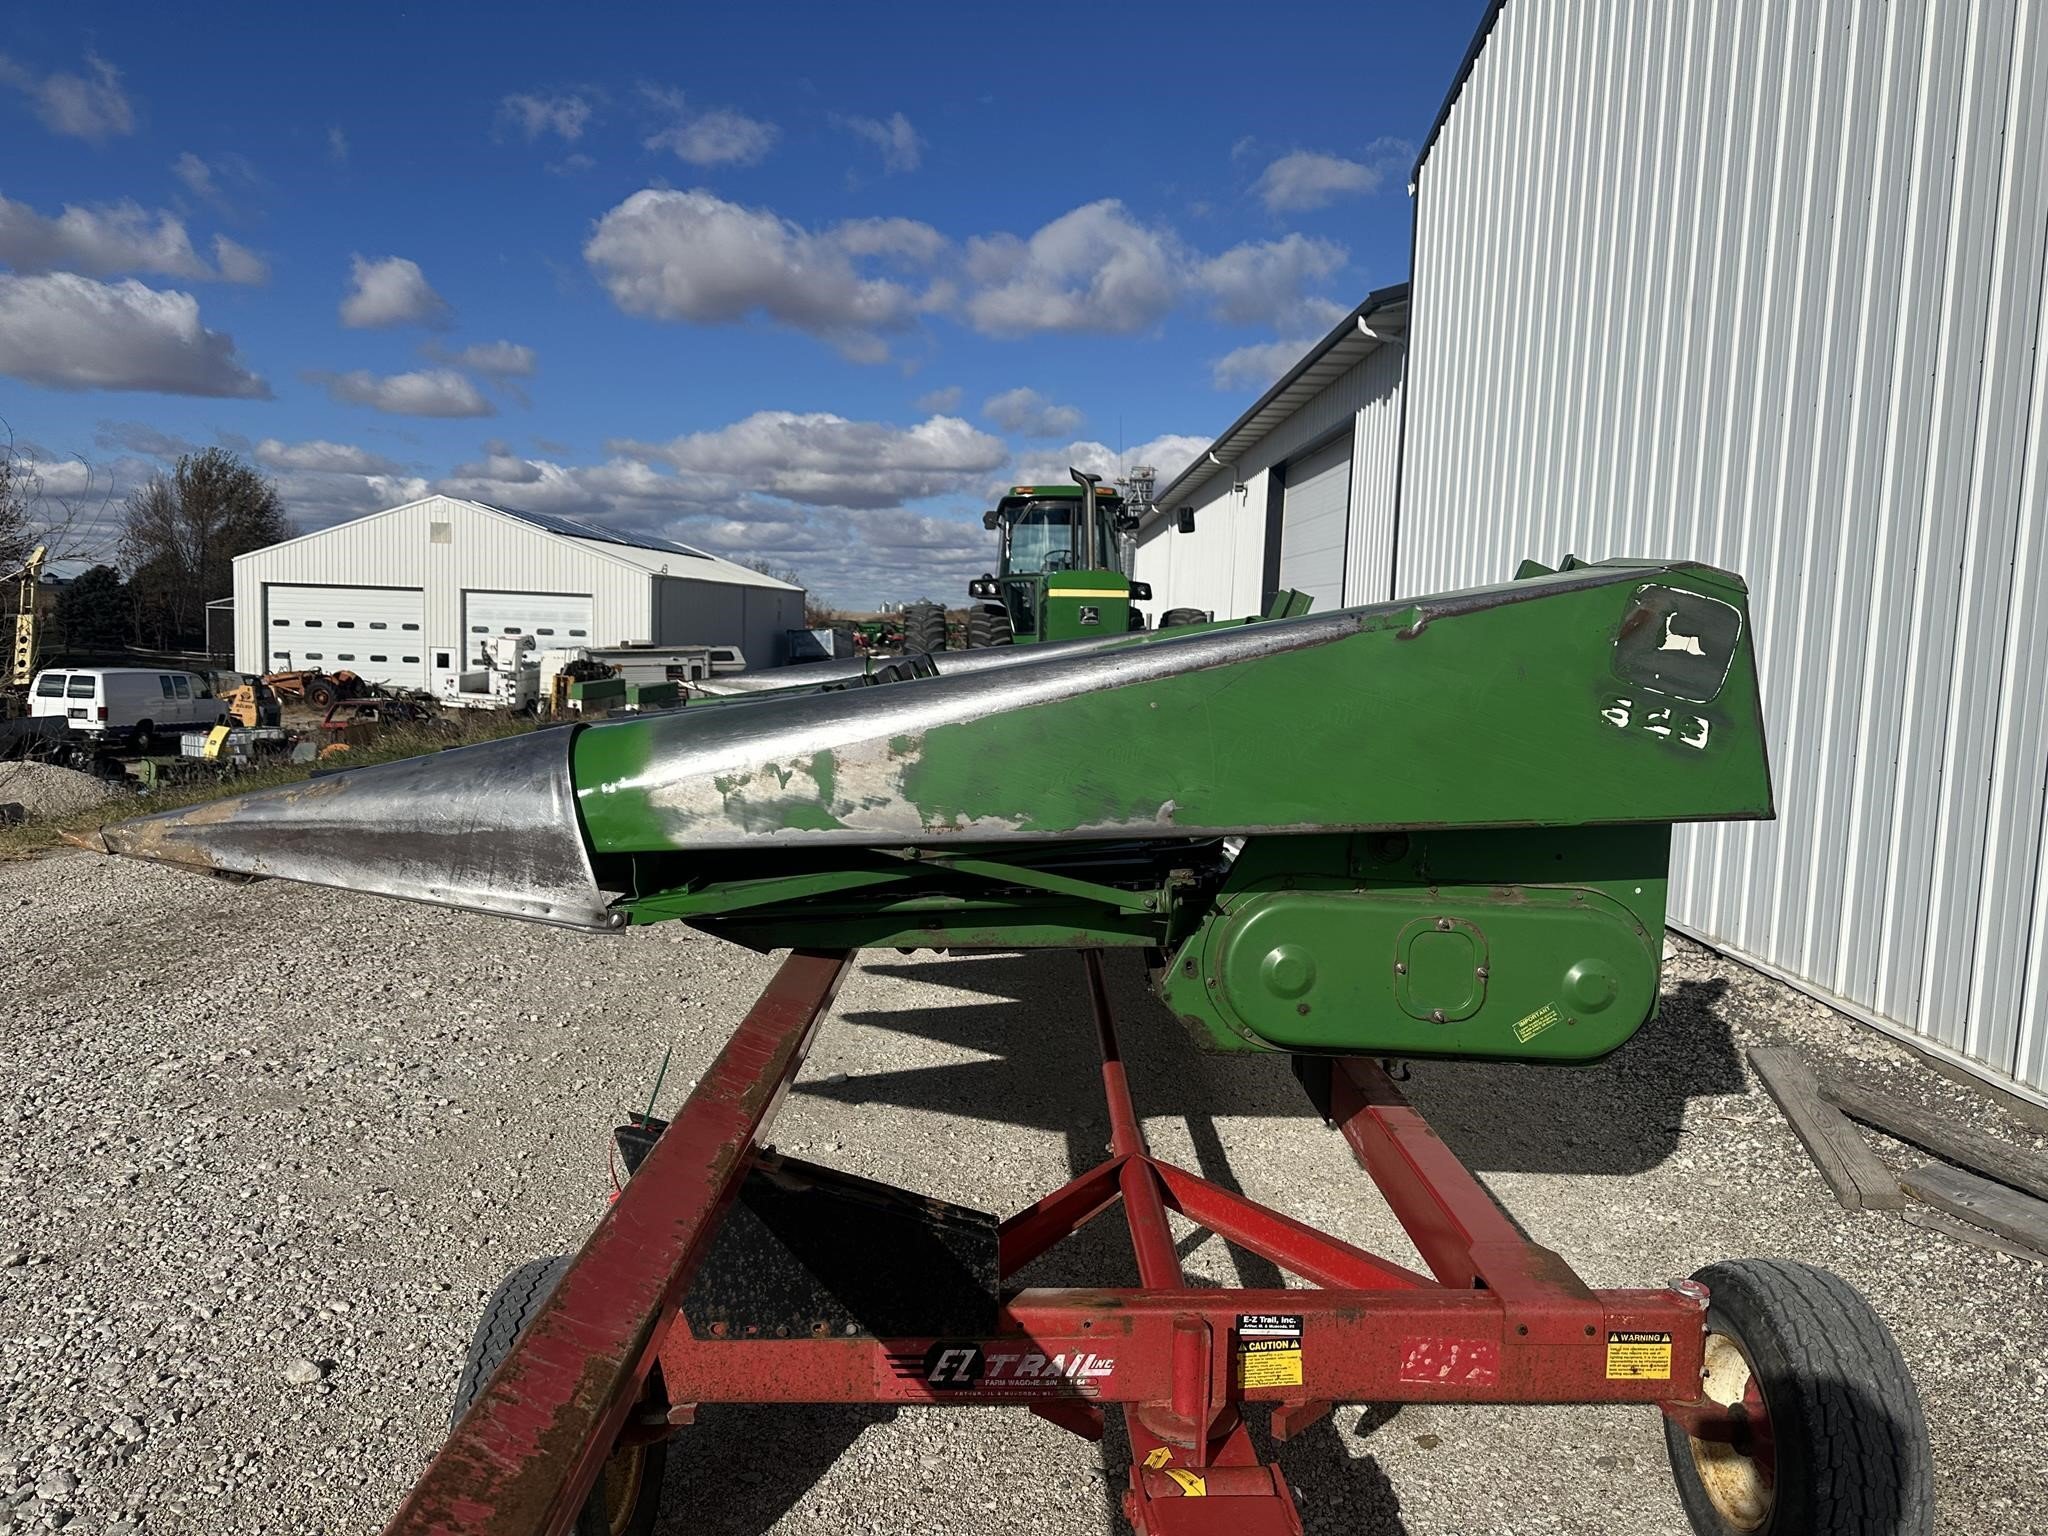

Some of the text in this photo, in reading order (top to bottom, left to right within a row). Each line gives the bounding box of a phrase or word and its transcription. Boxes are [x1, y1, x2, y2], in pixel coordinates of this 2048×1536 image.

[1519, 1006, 1550, 1028] IMPORTANT
[1281, 1316, 1296, 1324] Inc.
[1621, 1334, 1660, 1342] WARNING
[1249, 1341, 1289, 1351] CAUTION
[986, 1353, 1113, 1377] TRAIL
[1091, 1358, 1115, 1369] INC.
